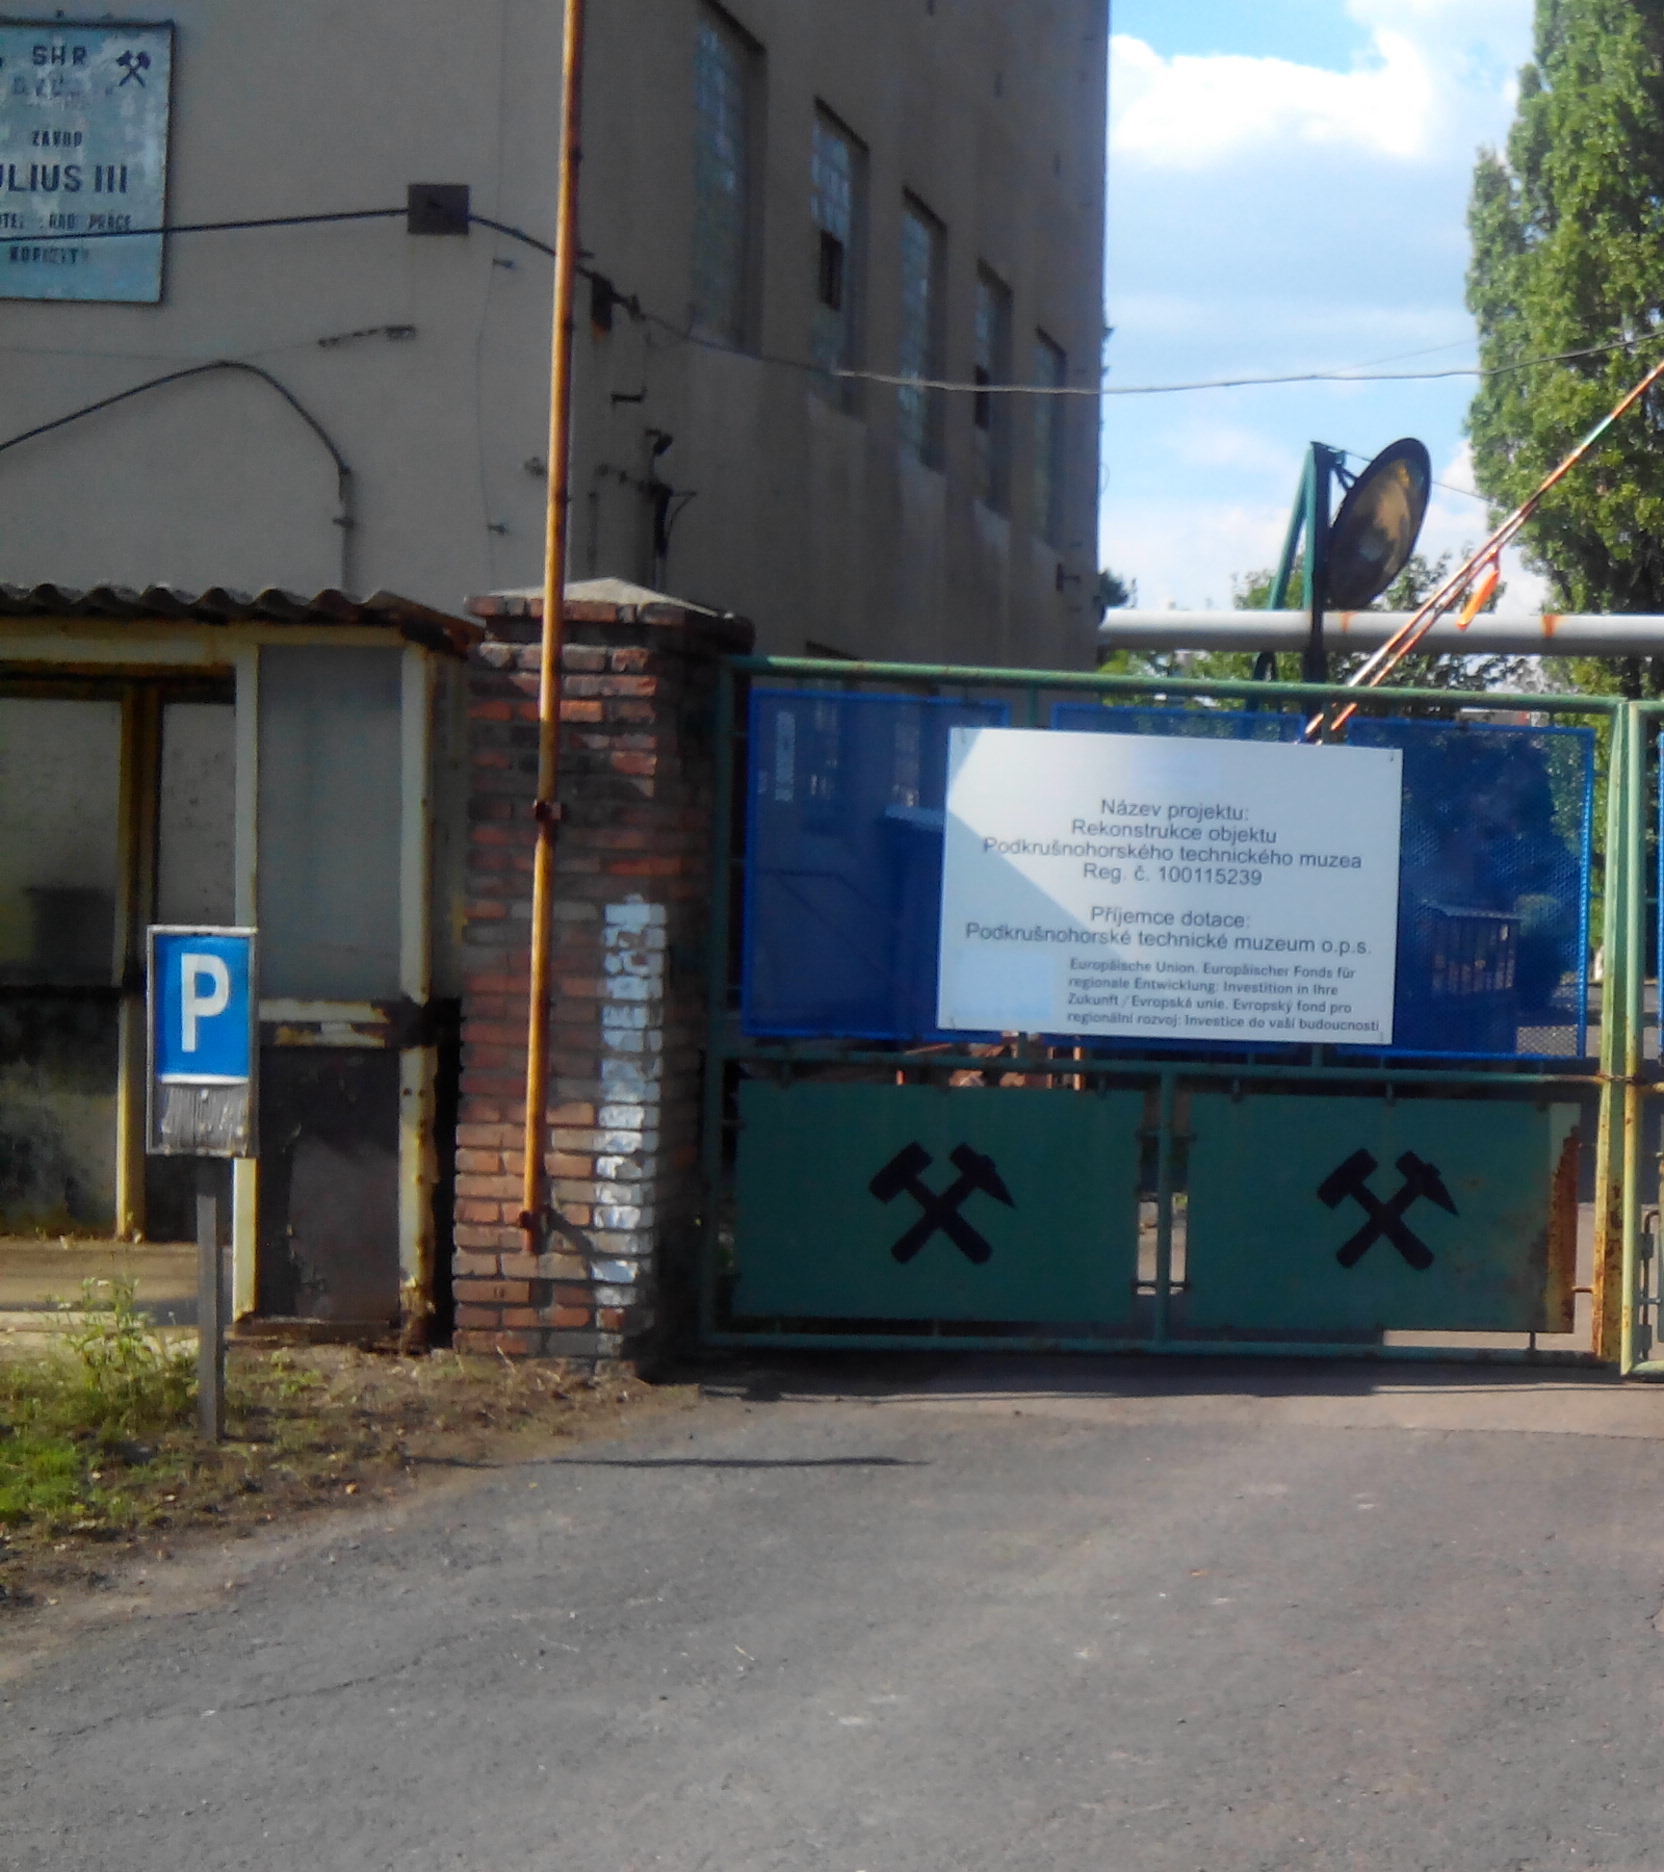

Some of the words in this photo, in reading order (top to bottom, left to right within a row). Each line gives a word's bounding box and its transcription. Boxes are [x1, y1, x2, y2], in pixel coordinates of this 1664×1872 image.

[0, 164, 82, 192] LIUS
[95, 165, 128, 193] III
[1101, 798, 1161, 817] Název
[1168, 804, 1249, 823] projektu:
[1071, 818, 1202, 841] Rekonstrukce
[1208, 826, 1277, 846] objektu
[983, 836, 1174, 861] Podkrušnohorského
[1180, 846, 1294, 867] technického
[1300, 853, 1362, 869] muzea
[1083, 862, 1126, 885] Reg.
[1134, 865, 1150, 882] č.
[1159, 866, 1263, 886] 100115239
[1091, 906, 1175, 927] Příjemce
[1181, 911, 1249, 929] dotace:
[966, 922, 1132, 945] Podkrušnohorské
[1138, 930, 1228, 949] technické
[1234, 936, 1315, 953] muzeum
[1322, 940, 1371, 957] o.p.s.
[1070, 957, 1152, 973] Europäische
[1203, 962, 1289, 977] Europäischer
[1294, 965, 1333, 979] Fonds
[1337, 966, 1357, 979] für
[1068, 977, 1130, 990] regionale
[1223, 981, 1293, 995] Investition
[1297, 983, 1309, 996] in
[1313, 983, 1338, 996] Ihre
[181, 952, 230, 1052] P
[1067, 992, 1119, 1006] Zukunft
[1131, 995, 1192, 1010] Evropská
[1233, 999, 1293, 1014] Evropský
[1297, 1000, 1326, 1013] fond
[1330, 1003, 1352, 1015] pro
[1067, 1012, 1133, 1025] regionální
[1184, 1015, 1245, 1028] Investice
[1248, 1017, 1265, 1029] do
[1269, 1017, 1295, 1029] vaší
[1299, 1018, 1380, 1032] budoucnosti
